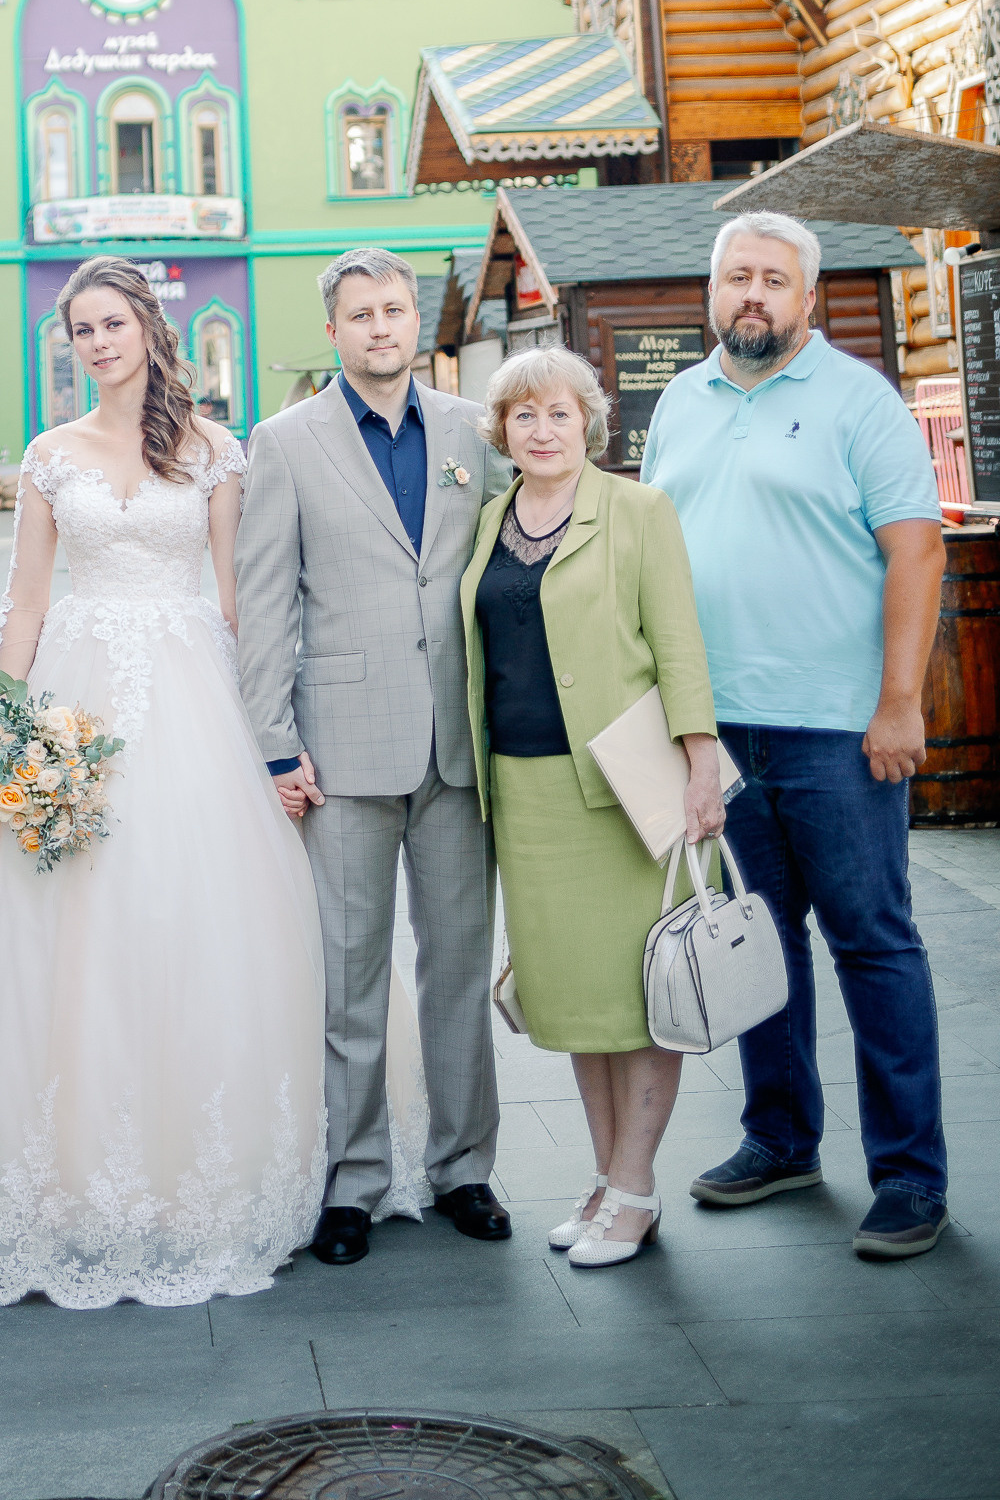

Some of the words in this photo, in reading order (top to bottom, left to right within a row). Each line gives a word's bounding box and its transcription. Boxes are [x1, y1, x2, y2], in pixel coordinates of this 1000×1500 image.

[103, 32, 158, 54] музей
[44, 47, 143, 77] Дедушкин
[147, 46, 217, 76] чердак
[638, 335, 680, 352] Морс
[646, 361, 676, 372] MORS
